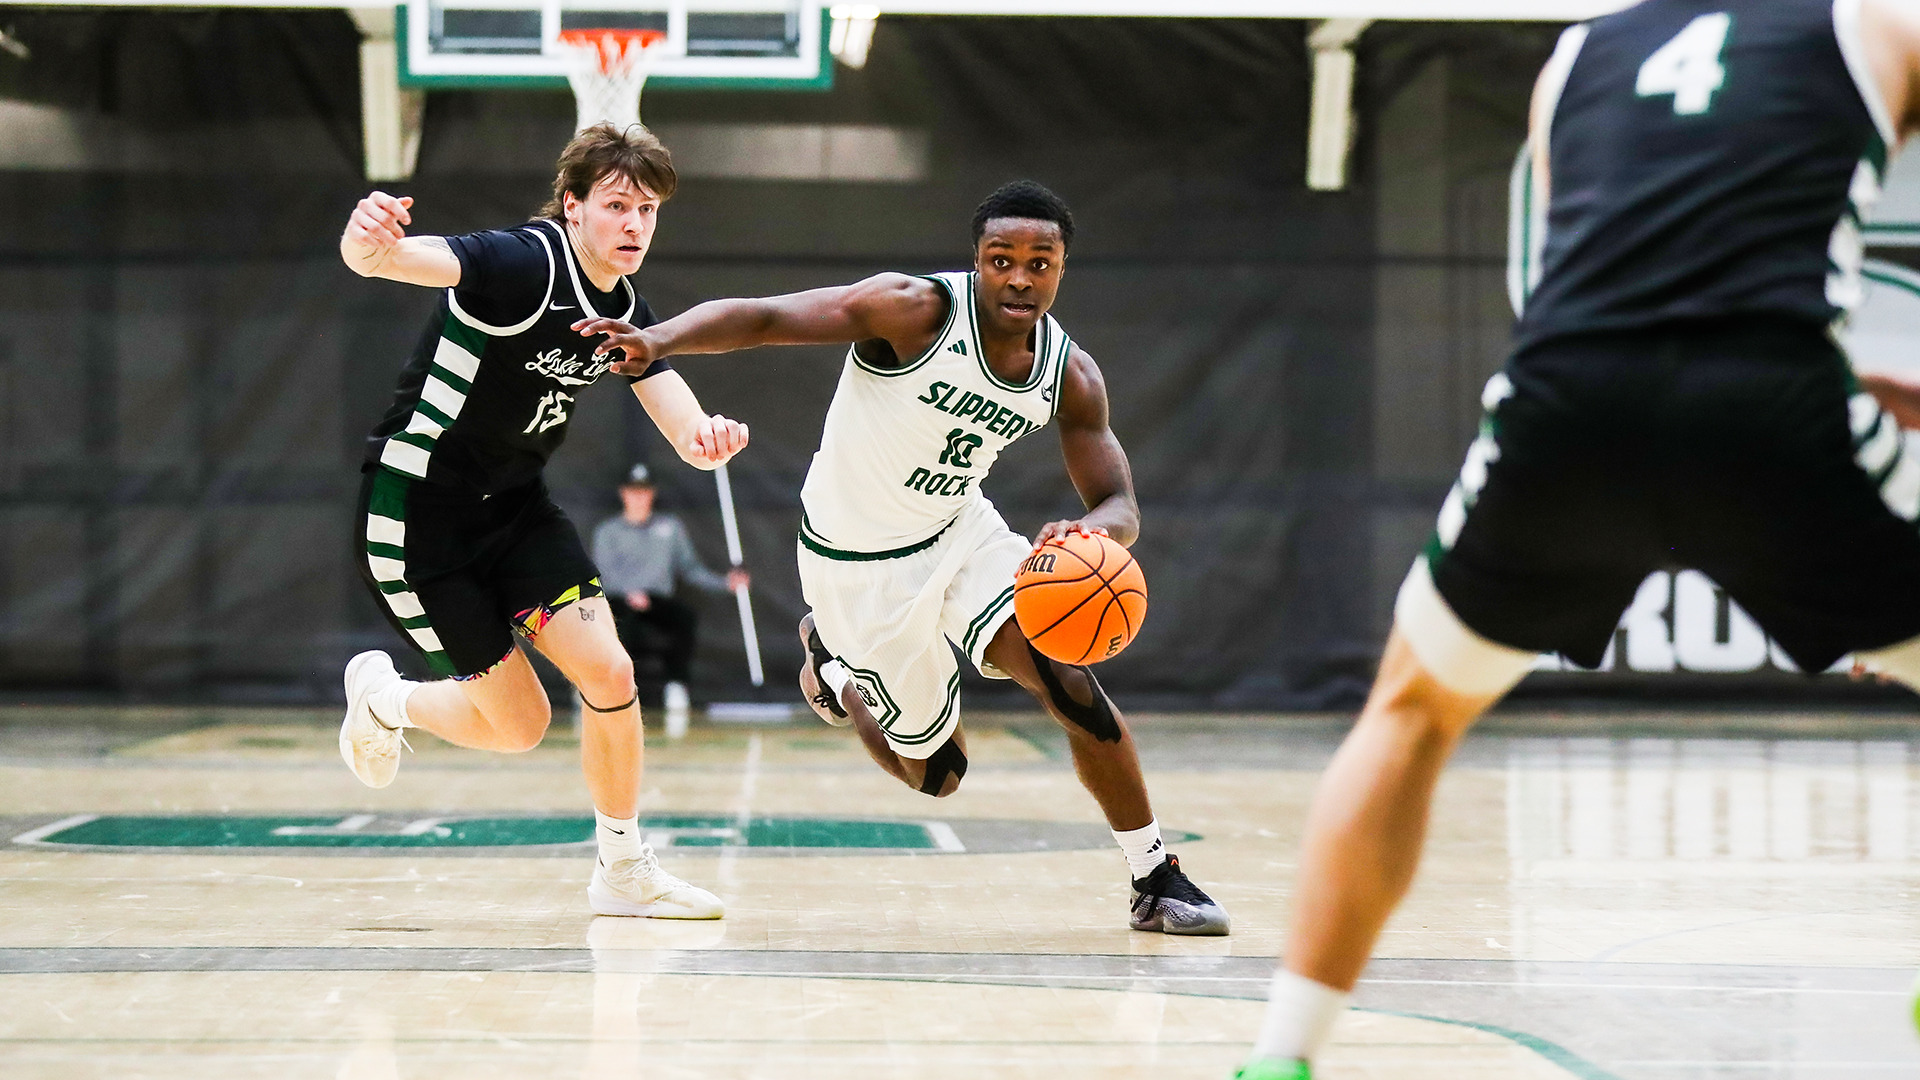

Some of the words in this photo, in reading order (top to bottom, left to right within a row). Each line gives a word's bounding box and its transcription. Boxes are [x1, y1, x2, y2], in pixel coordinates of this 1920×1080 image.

[1635, 11, 1731, 116] 4
[525, 348, 583, 376] Lake
[522, 390, 574, 433] 15
[917, 380, 1042, 440] SLIPPERY
[938, 427, 983, 469] 10
[904, 466, 976, 496] ROCK
